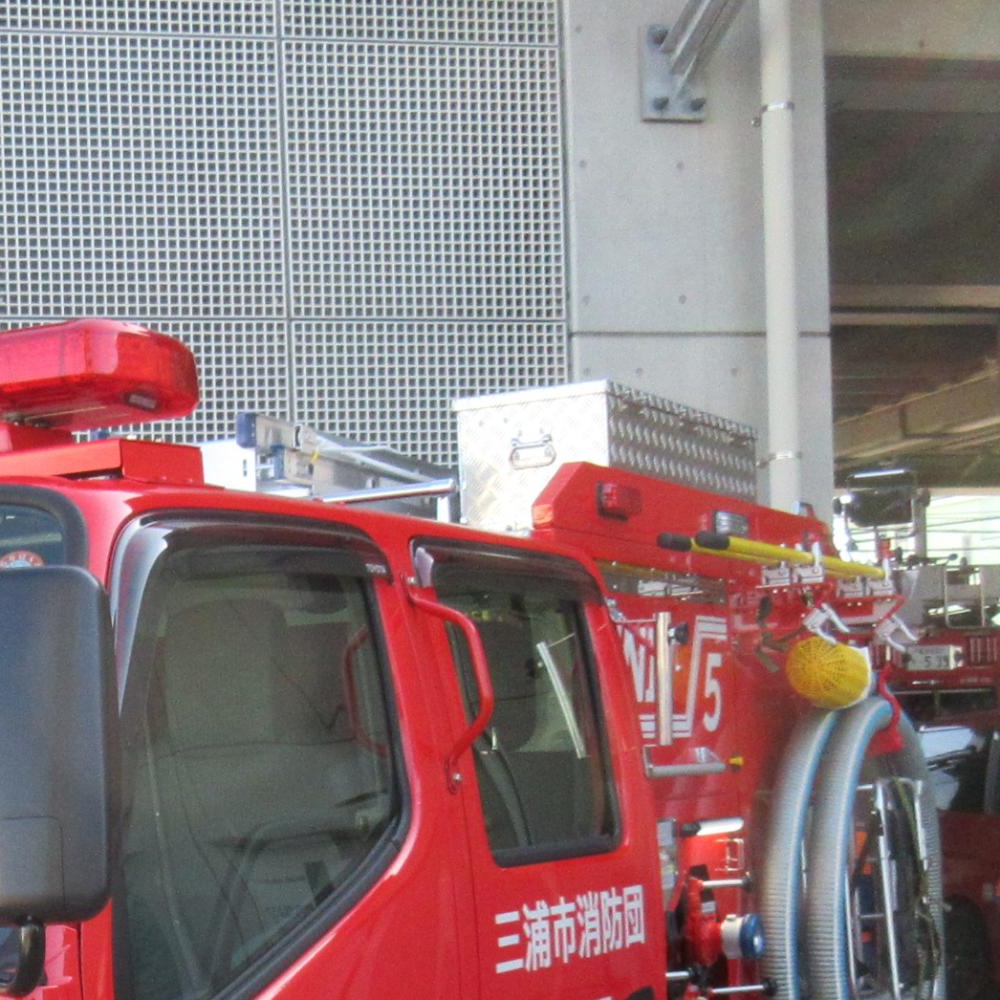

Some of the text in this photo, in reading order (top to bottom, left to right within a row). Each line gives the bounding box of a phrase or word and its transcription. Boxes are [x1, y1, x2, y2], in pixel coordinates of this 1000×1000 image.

[703, 653, 722, 732] 5
[495, 885, 645, 974] 三浦市消防団
